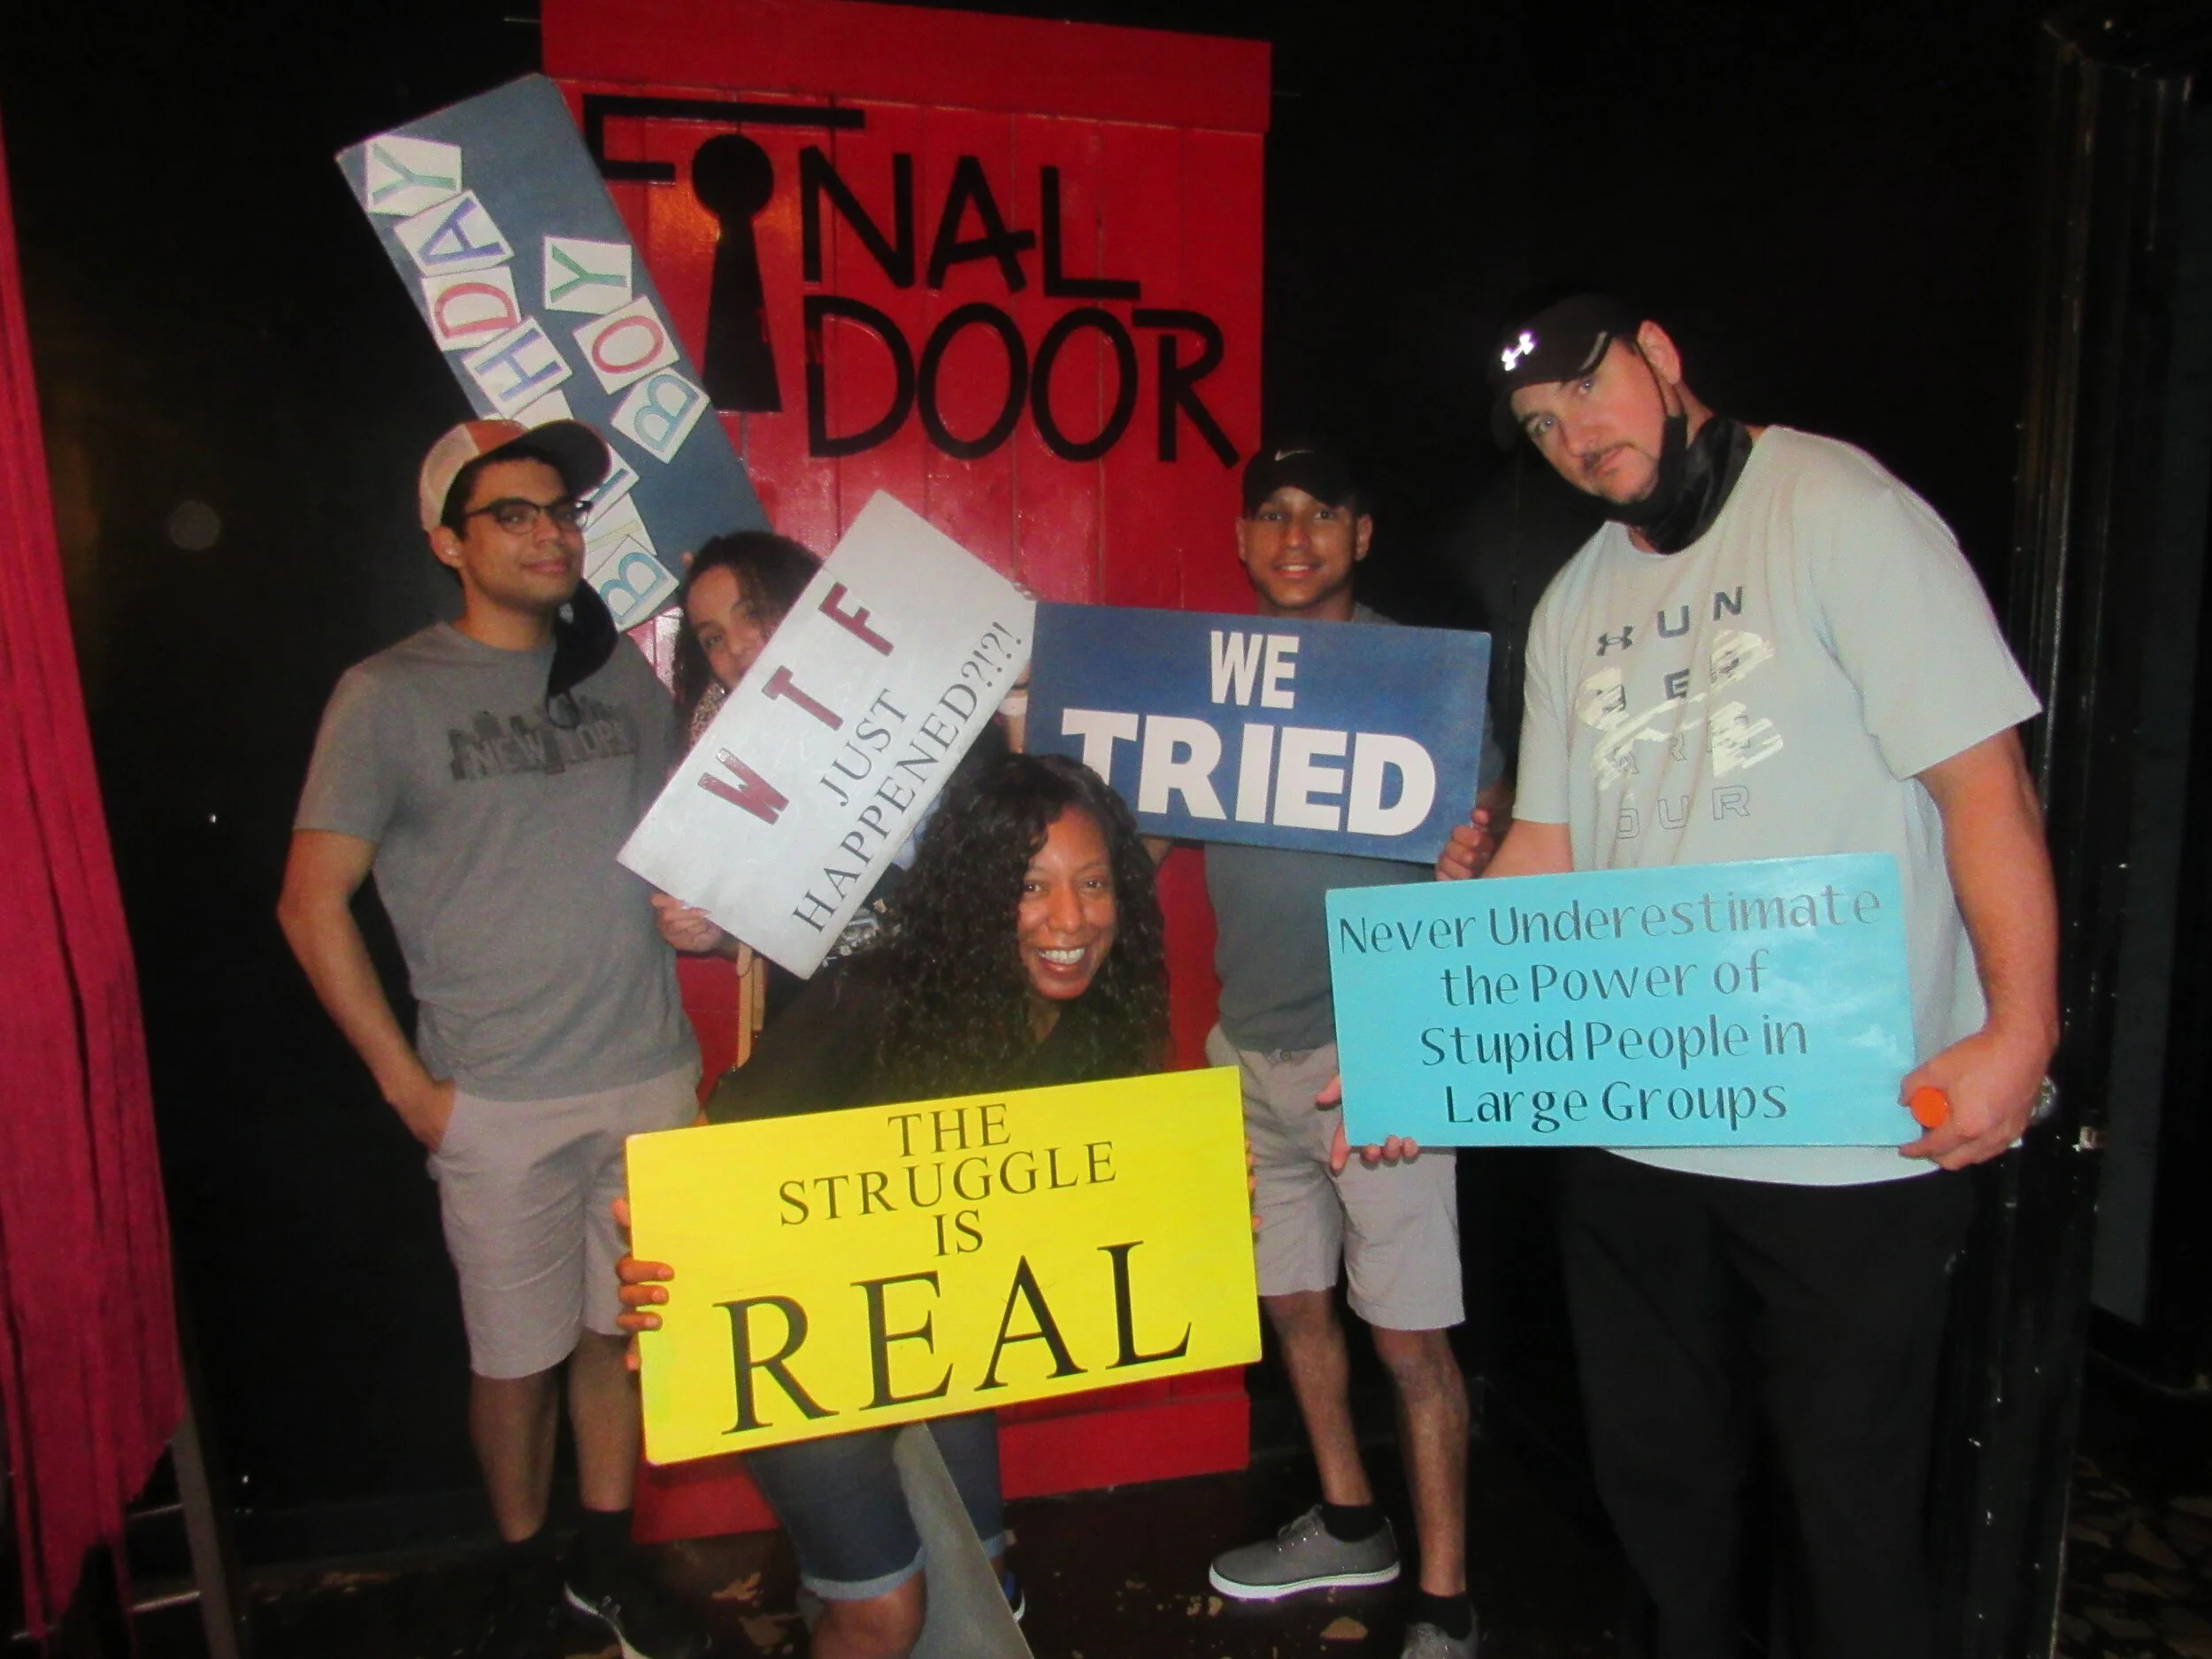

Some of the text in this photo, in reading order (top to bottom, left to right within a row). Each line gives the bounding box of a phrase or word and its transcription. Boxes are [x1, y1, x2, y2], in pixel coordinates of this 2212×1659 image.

[549, 244, 697, 454] BOY
[803, 294, 1240, 470] DOOR
[1210, 629, 1300, 710] WE
[793, 621, 1023, 935] HAPPENED?!?!
[818, 688, 910, 807] JUST
[1062, 708, 1437, 836] TRIED
[1339, 885, 1882, 954] Never Underestimate
[1440, 949, 1770, 1007] the Power of
[1420, 1014, 1808, 1074] Stupid People in
[887, 1102, 1012, 1158] THE
[1446, 1081, 1788, 1133] Large Groups
[779, 1141, 1118, 1226] STRUGGLE
[933, 1209, 985, 1257] IS
[712, 1240, 1194, 1435] REAL
